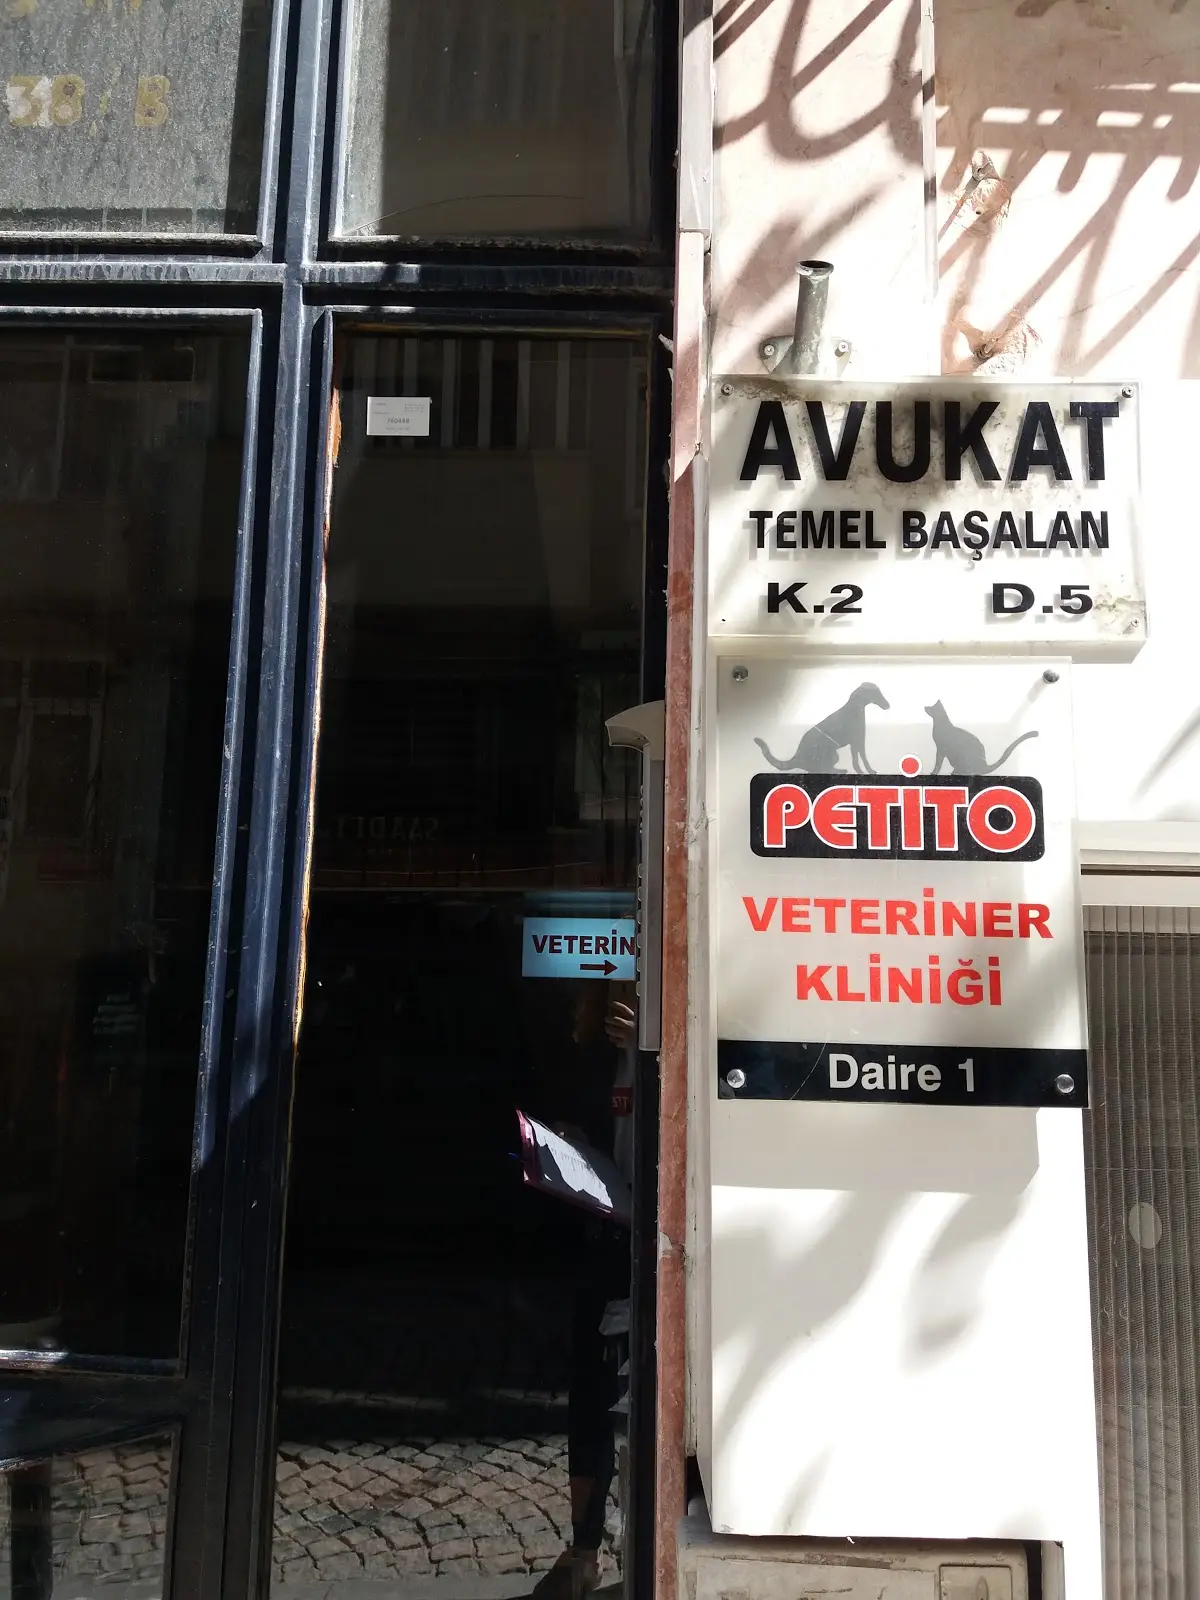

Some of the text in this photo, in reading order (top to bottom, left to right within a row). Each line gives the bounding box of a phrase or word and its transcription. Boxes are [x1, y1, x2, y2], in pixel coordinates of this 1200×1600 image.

[135, 74, 170, 126] B
[739, 400, 1120, 483] AVUKAT
[749, 510, 1110, 561] TEMEL BAŞALAN
[766, 582, 1093, 615] K.2 D.5
[762, 754, 1036, 853] PETİTO
[742, 887, 1054, 939] VETERİNER
[532, 929, 635, 955] VETERİN
[796, 953, 1003, 1006] KLİNİĞİ
[828, 1053, 976, 1092] Daire 1
